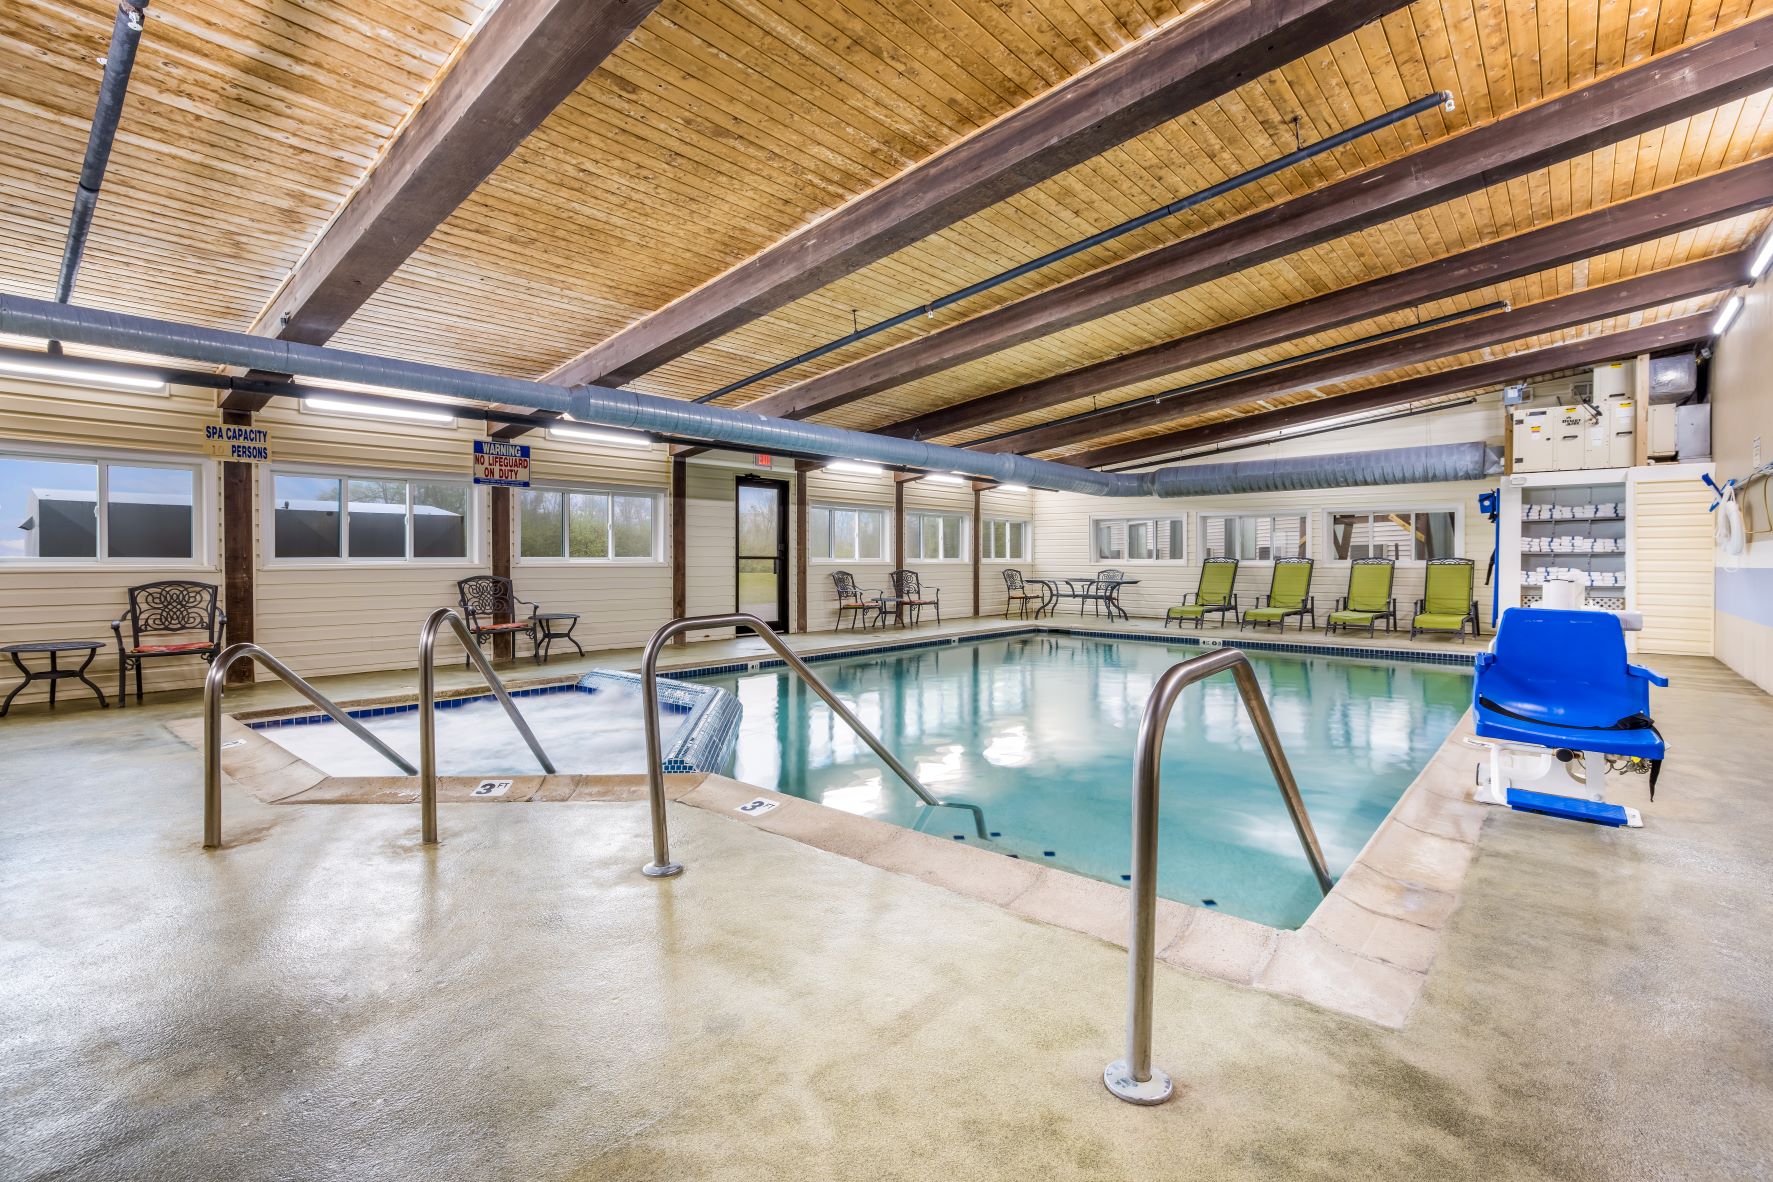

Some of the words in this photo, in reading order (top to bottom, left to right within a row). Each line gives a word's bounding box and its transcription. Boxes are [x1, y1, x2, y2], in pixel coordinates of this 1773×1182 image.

[206, 426, 223, 439] SPA
[226, 428, 268, 442] CAPACITY
[232, 445, 268, 459] PERSONS
[482, 443, 521, 456] WARNING
[475, 454, 485, 465] NO
[488, 456, 528, 469] LIFEGUARD
[484, 467, 494, 478] ON
[499, 468, 519, 479] DUTY
[475, 783, 496, 795] 3
[740, 801, 764, 811] 3
